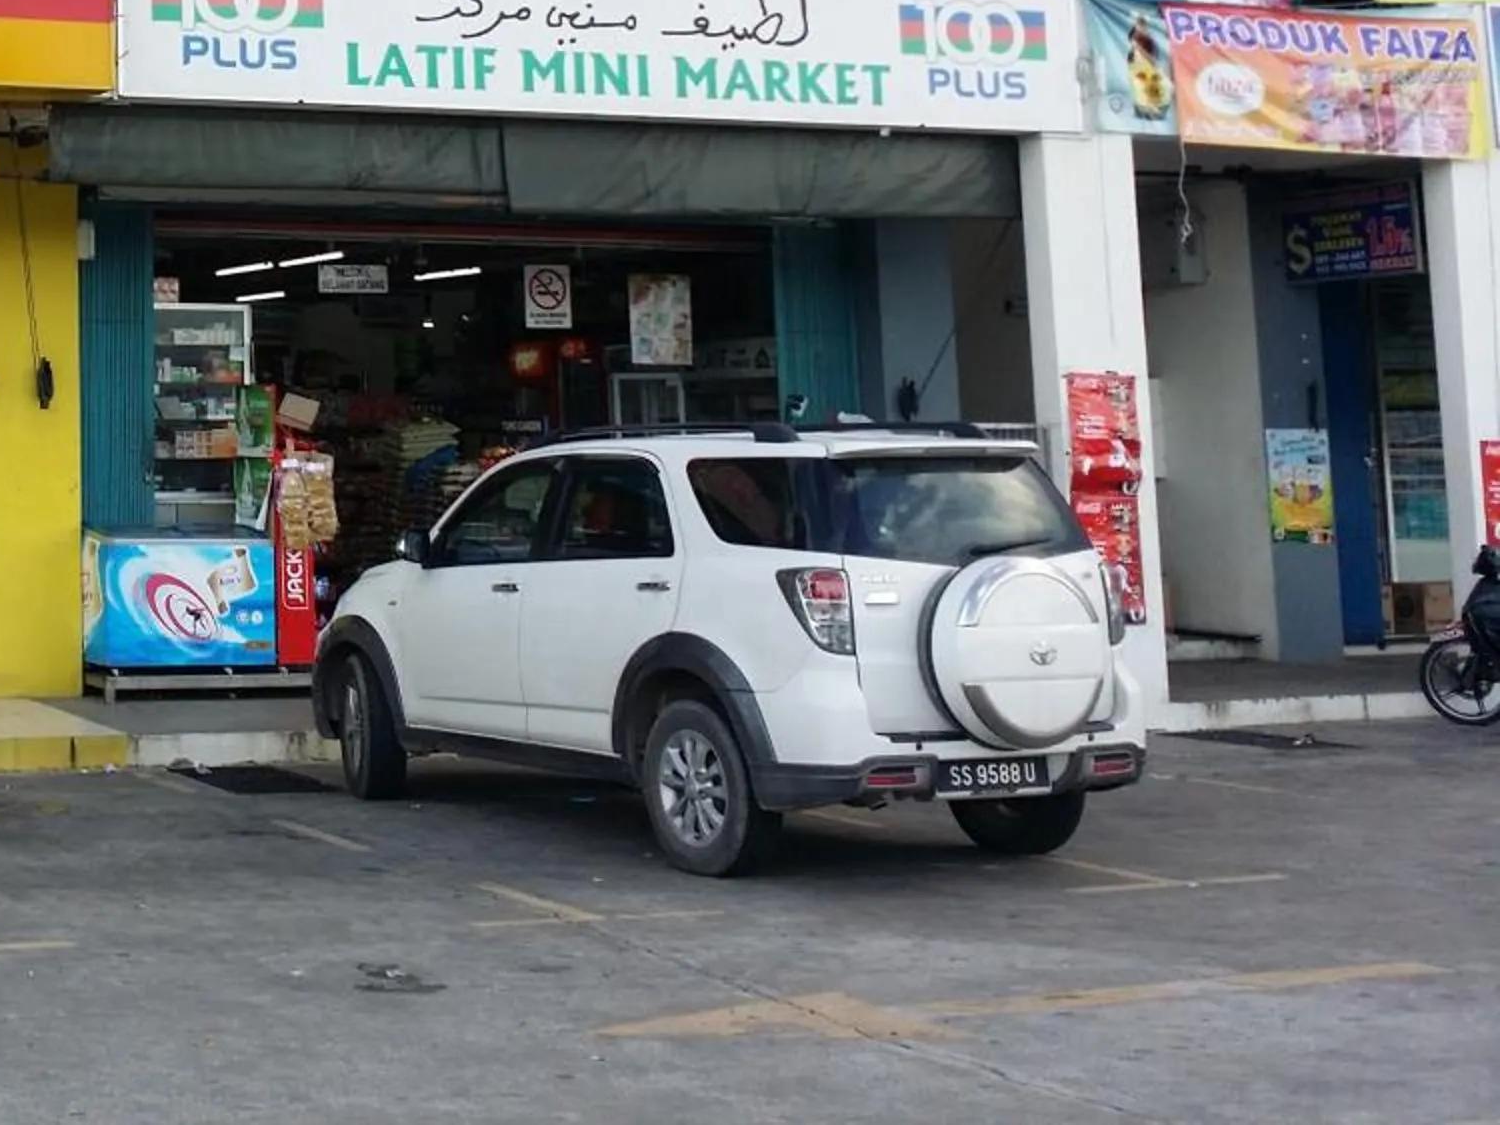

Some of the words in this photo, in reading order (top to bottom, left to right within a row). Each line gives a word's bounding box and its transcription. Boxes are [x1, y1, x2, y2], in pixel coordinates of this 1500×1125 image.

[182, 35, 298, 70] PLUS
[1168, 10, 1349, 56] PRODUK
[1359, 26, 1478, 64] FAIZA
[345, 41, 498, 92] LATIF
[519, 48, 650, 98] MINI
[674, 55, 891, 107] MARKET
[927, 67, 1027, 100] PLUS
[949, 764, 975, 787] SS
[977, 761, 1021, 786] 9588
[1025, 761, 1037, 782] U
